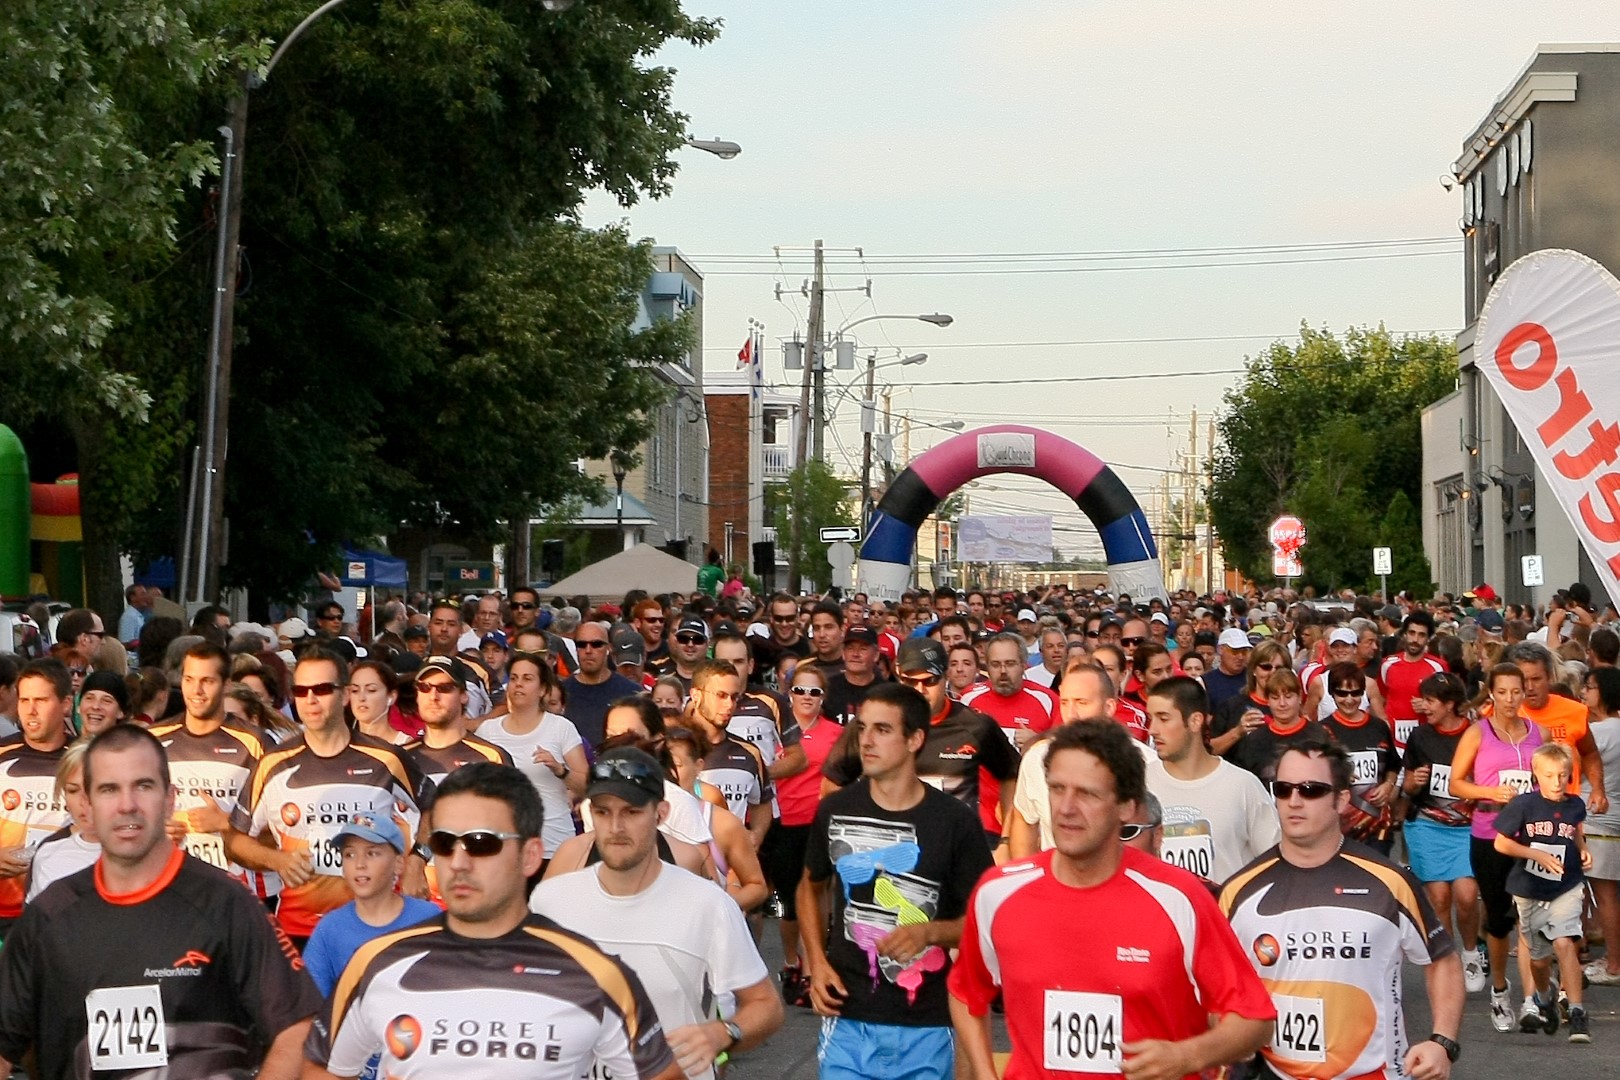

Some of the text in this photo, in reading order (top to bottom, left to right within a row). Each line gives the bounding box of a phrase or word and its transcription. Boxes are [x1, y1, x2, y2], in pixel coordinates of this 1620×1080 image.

[306, 801, 377, 813] SOREL
[1525, 820, 1554, 838] RED
[185, 841, 222, 867] 851
[1287, 930, 1372, 945] SOREL
[1286, 946, 1372, 961] FORGE
[95, 1005, 160, 1058] 2142
[431, 1018, 563, 1042] SOREL
[1051, 1010, 1116, 1060] 1804
[1274, 1010, 1321, 1052] 1422
[429, 1039, 563, 1062] FORGE
